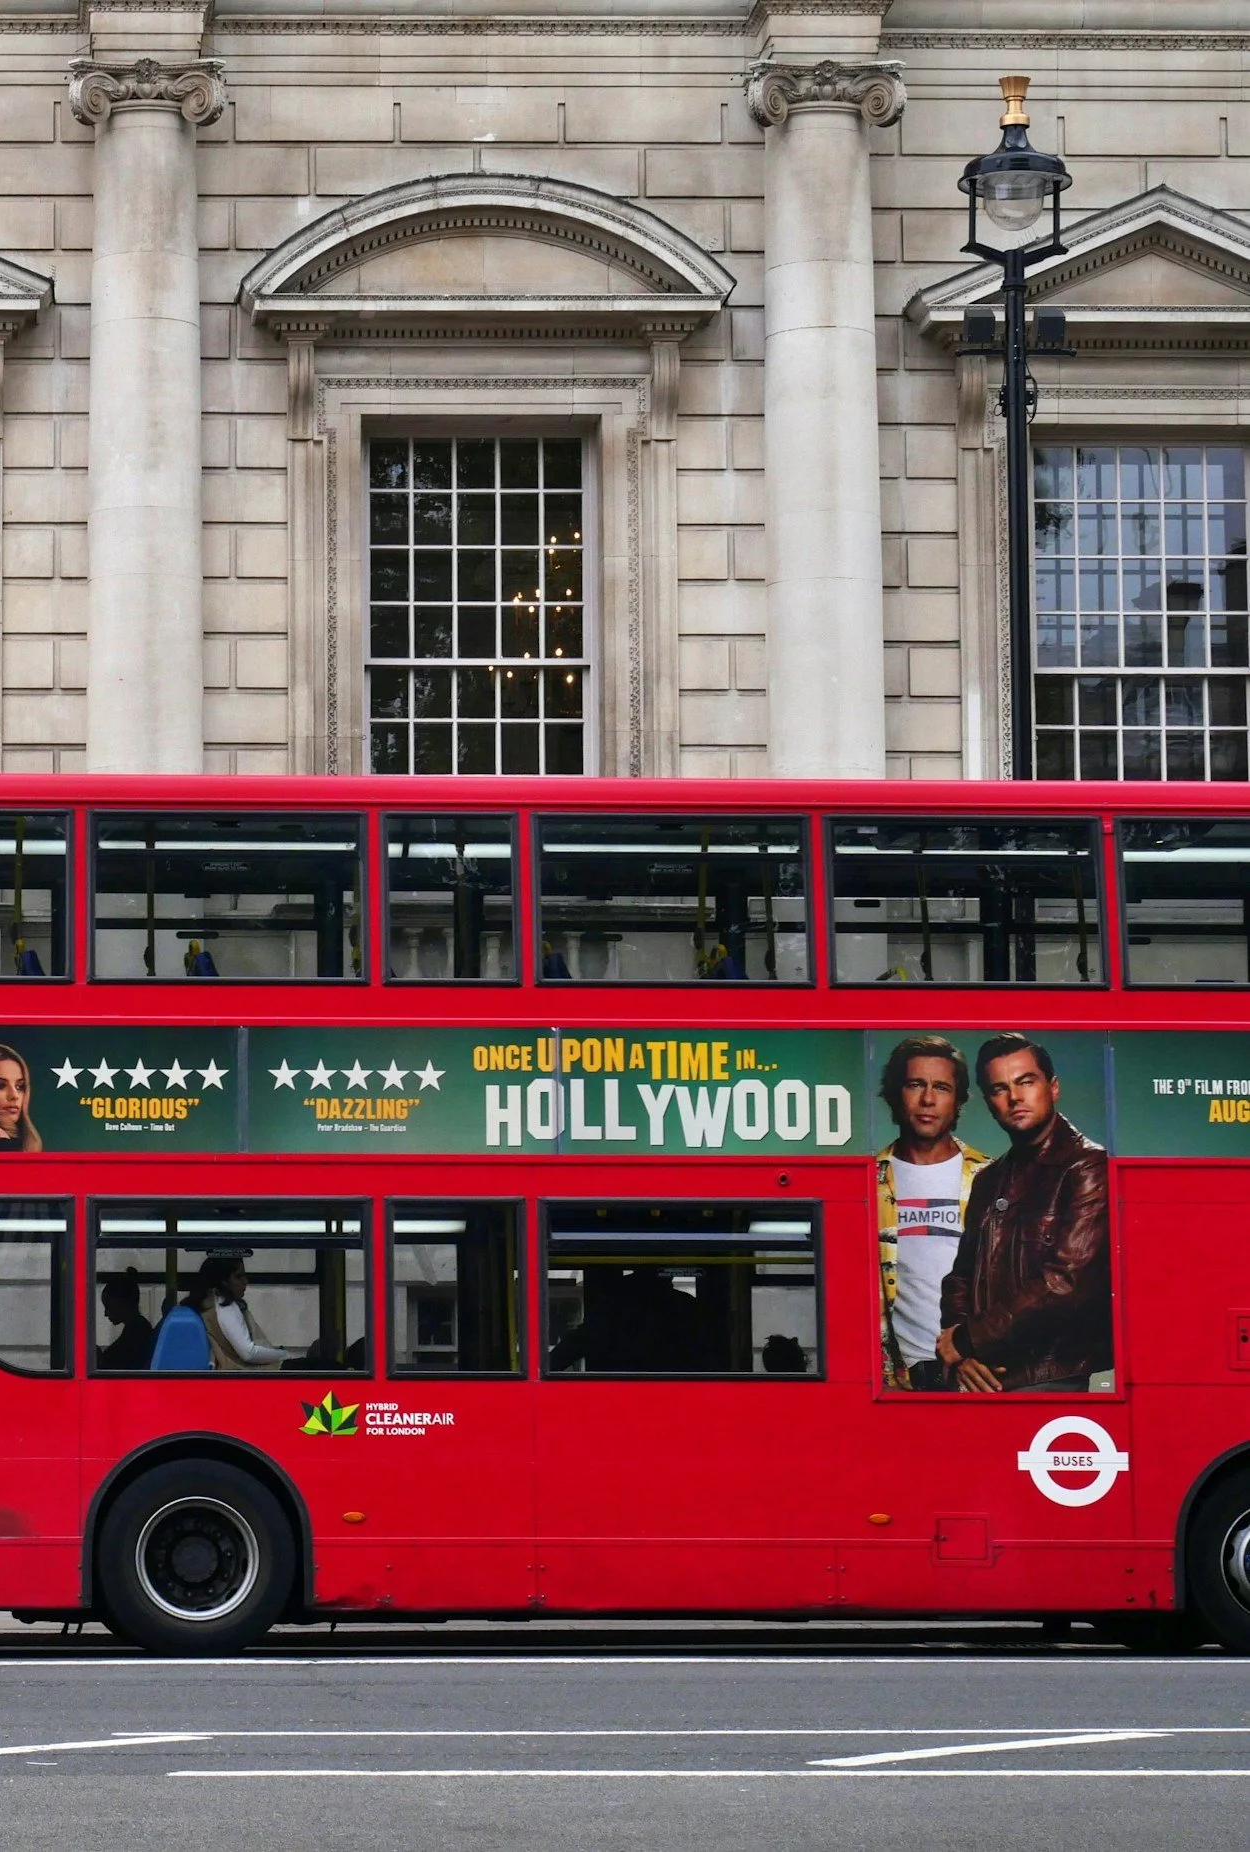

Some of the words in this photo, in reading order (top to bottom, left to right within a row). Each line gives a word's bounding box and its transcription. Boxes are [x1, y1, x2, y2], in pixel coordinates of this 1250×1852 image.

[473, 1045, 533, 1071] ONCE
[537, 1037, 625, 1073] UPON
[629, 1043, 646, 1070] A
[646, 1040, 730, 1081] TIME
[736, 1049, 778, 1072] IN...
[1153, 1079, 1174, 1095] THE
[1226, 1080, 1250, 1096] FRO
[485, 1078, 852, 1148] HOLLYWOOD
[150, 1122, 163, 1131] Time
[164, 1122, 175, 1131] Out
[317, 1123, 333, 1132] Peter
[334, 1123, 363, 1132] Bradshaw
[369, 1123, 379, 1132] The
[380, 1123, 406, 1132] Guardian
[898, 1211, 961, 1224] HAMPIO
[366, 1403, 398, 1411] HYBRID
[365, 1412, 454, 1426] CLEANERAIR
[366, 1428, 384, 1436] FOR
[386, 1428, 426, 1436] LONDON
[1053, 1456, 1093, 1466] BUSES
